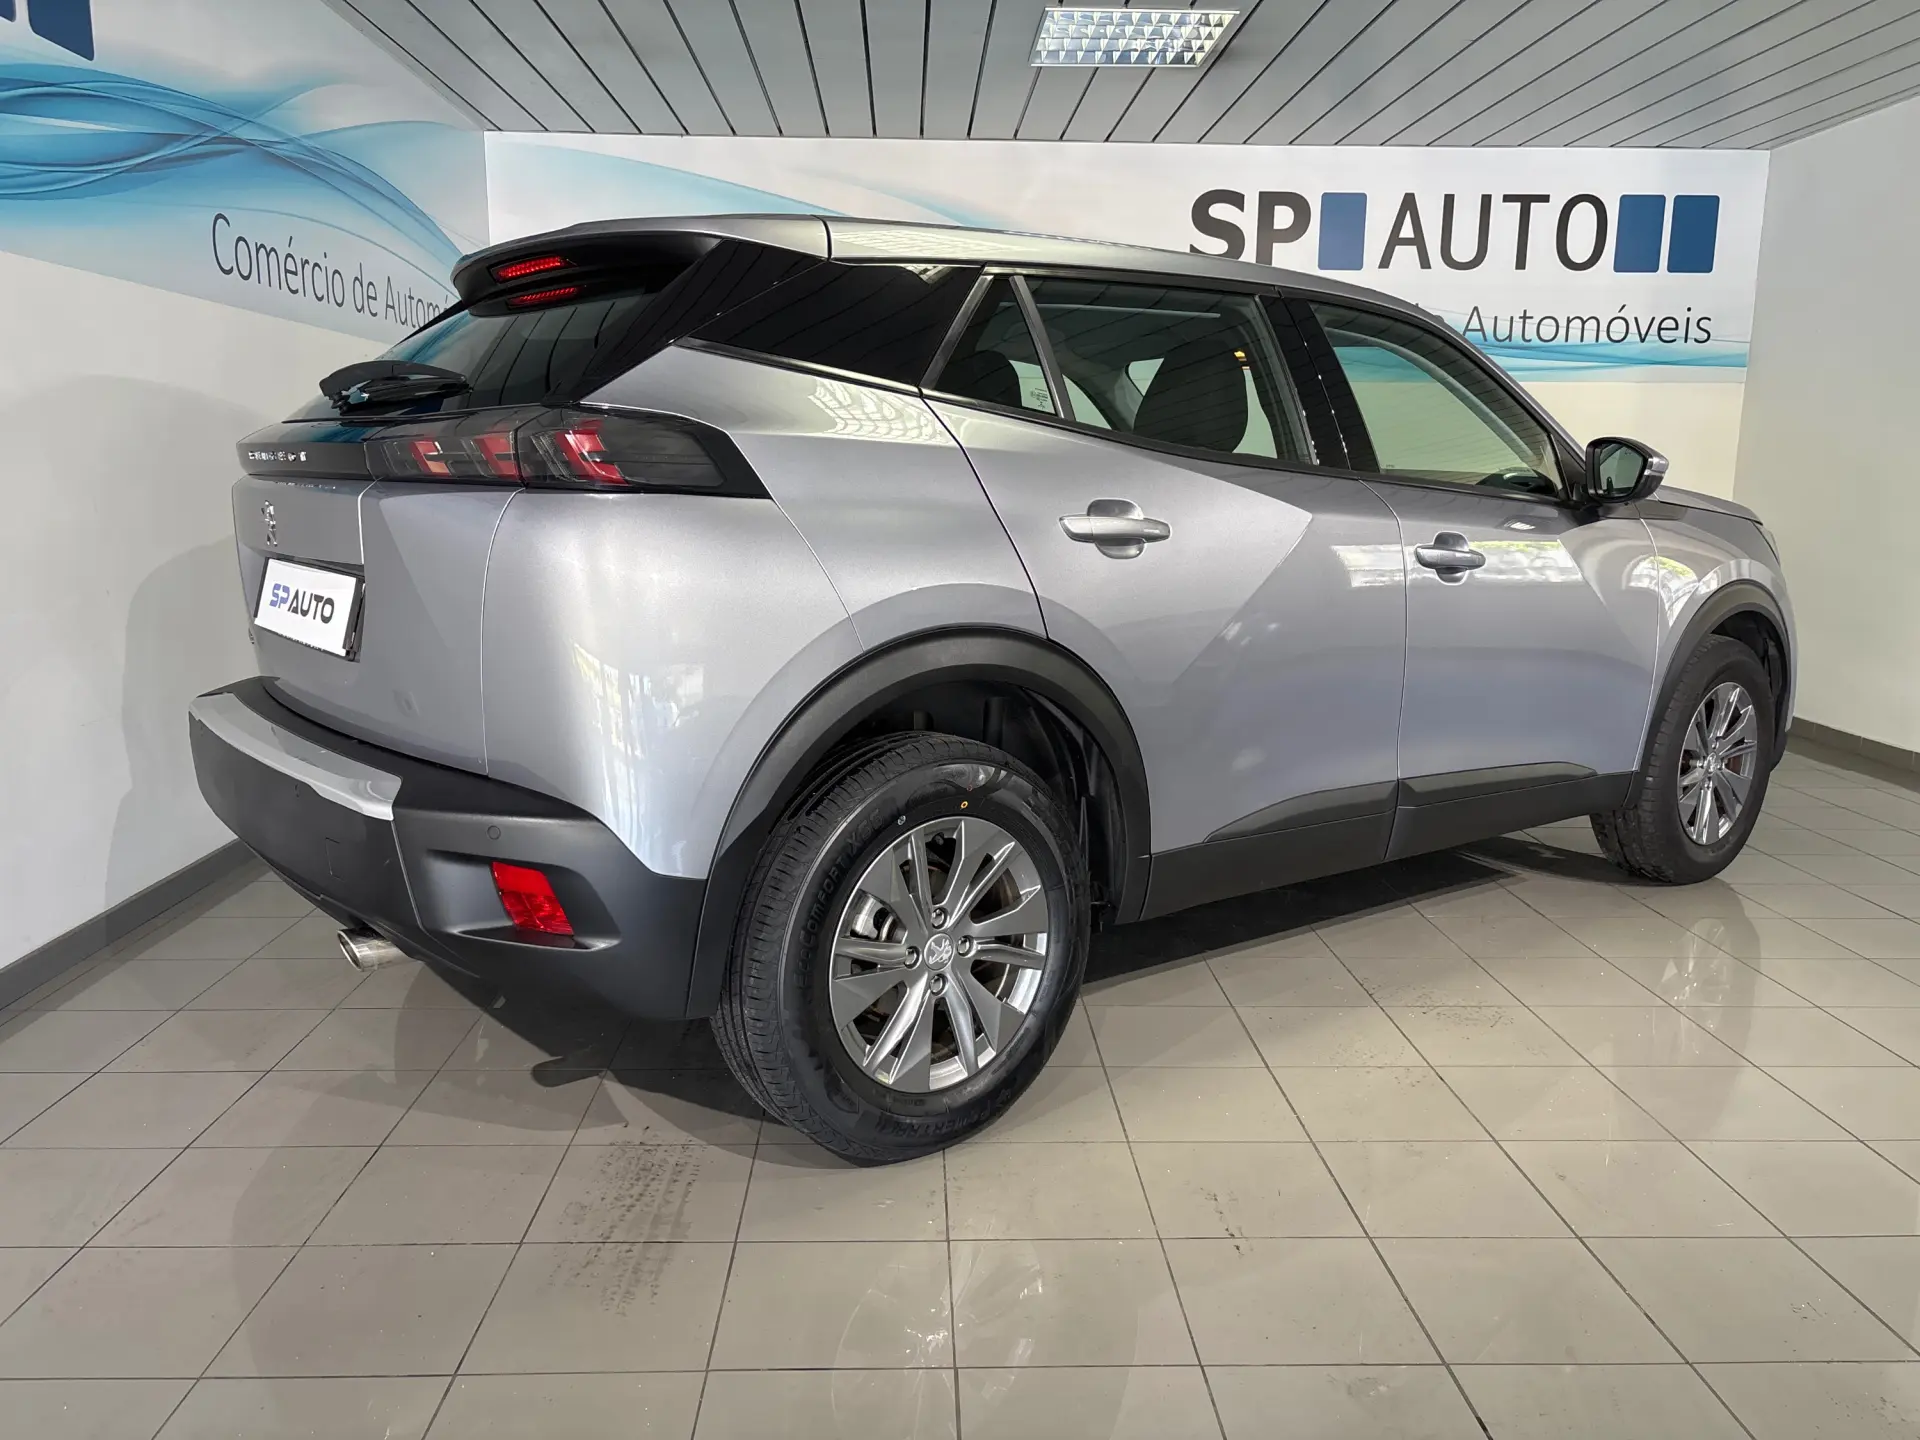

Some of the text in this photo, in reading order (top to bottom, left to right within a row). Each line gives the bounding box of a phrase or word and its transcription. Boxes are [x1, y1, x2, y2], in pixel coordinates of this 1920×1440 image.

[1190, 188, 1609, 272] SP AUTO
[212, 212, 346, 308] Comércio
[352, 262, 378, 318] de
[1462, 303, 1712, 344] Automóveis
[287, 588, 335, 624] AUTO
